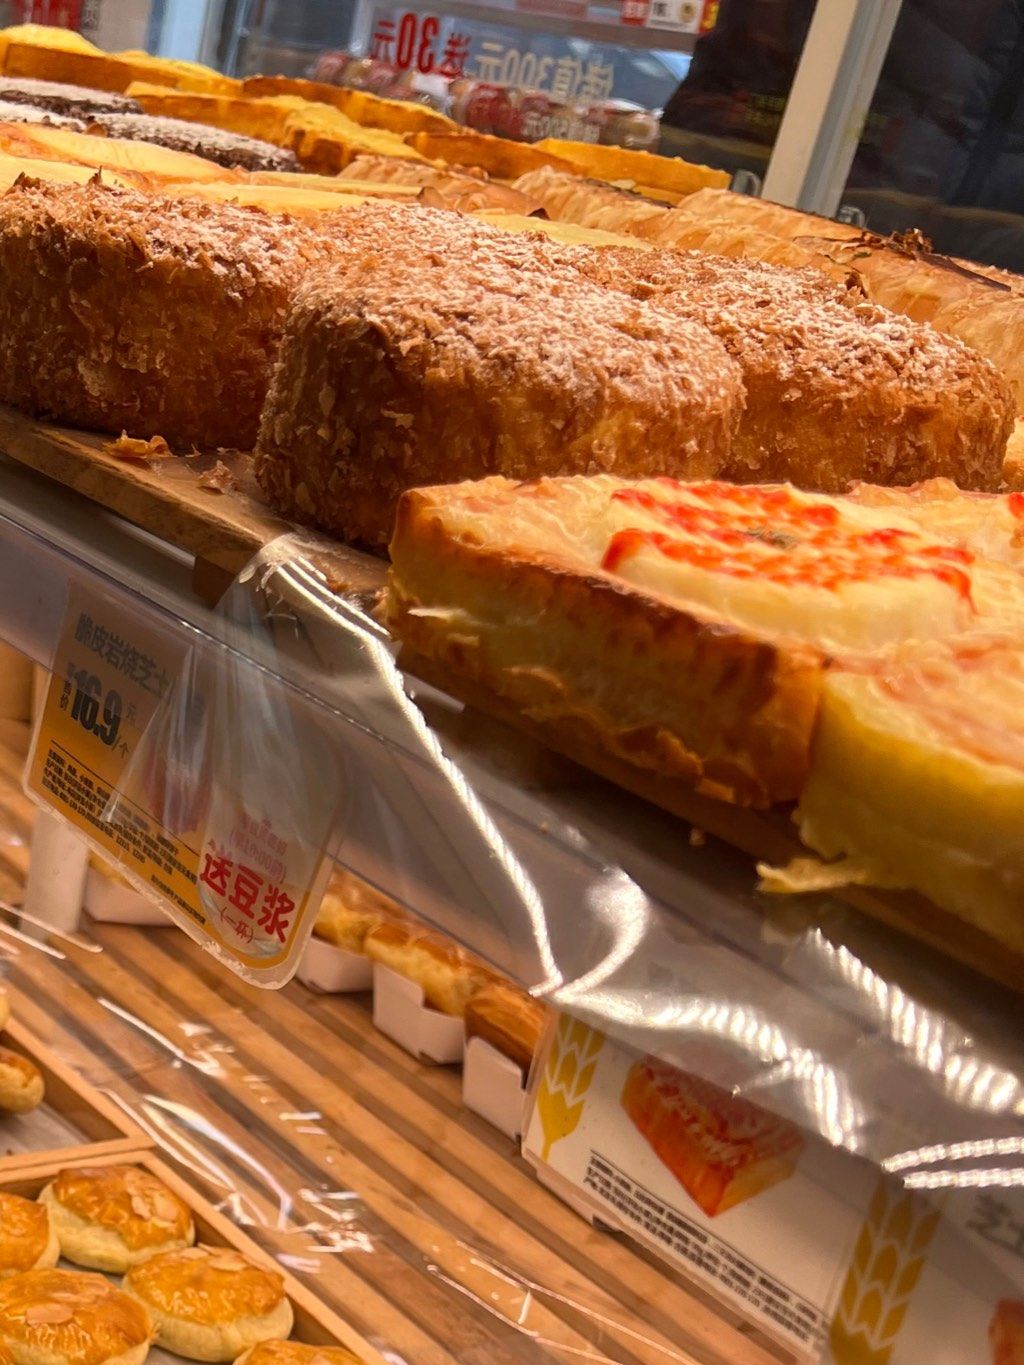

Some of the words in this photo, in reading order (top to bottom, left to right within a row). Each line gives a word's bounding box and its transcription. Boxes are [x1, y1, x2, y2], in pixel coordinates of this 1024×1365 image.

[71, 669, 123, 746] 16.9
[199, 853, 296, 944] 送豆浆
